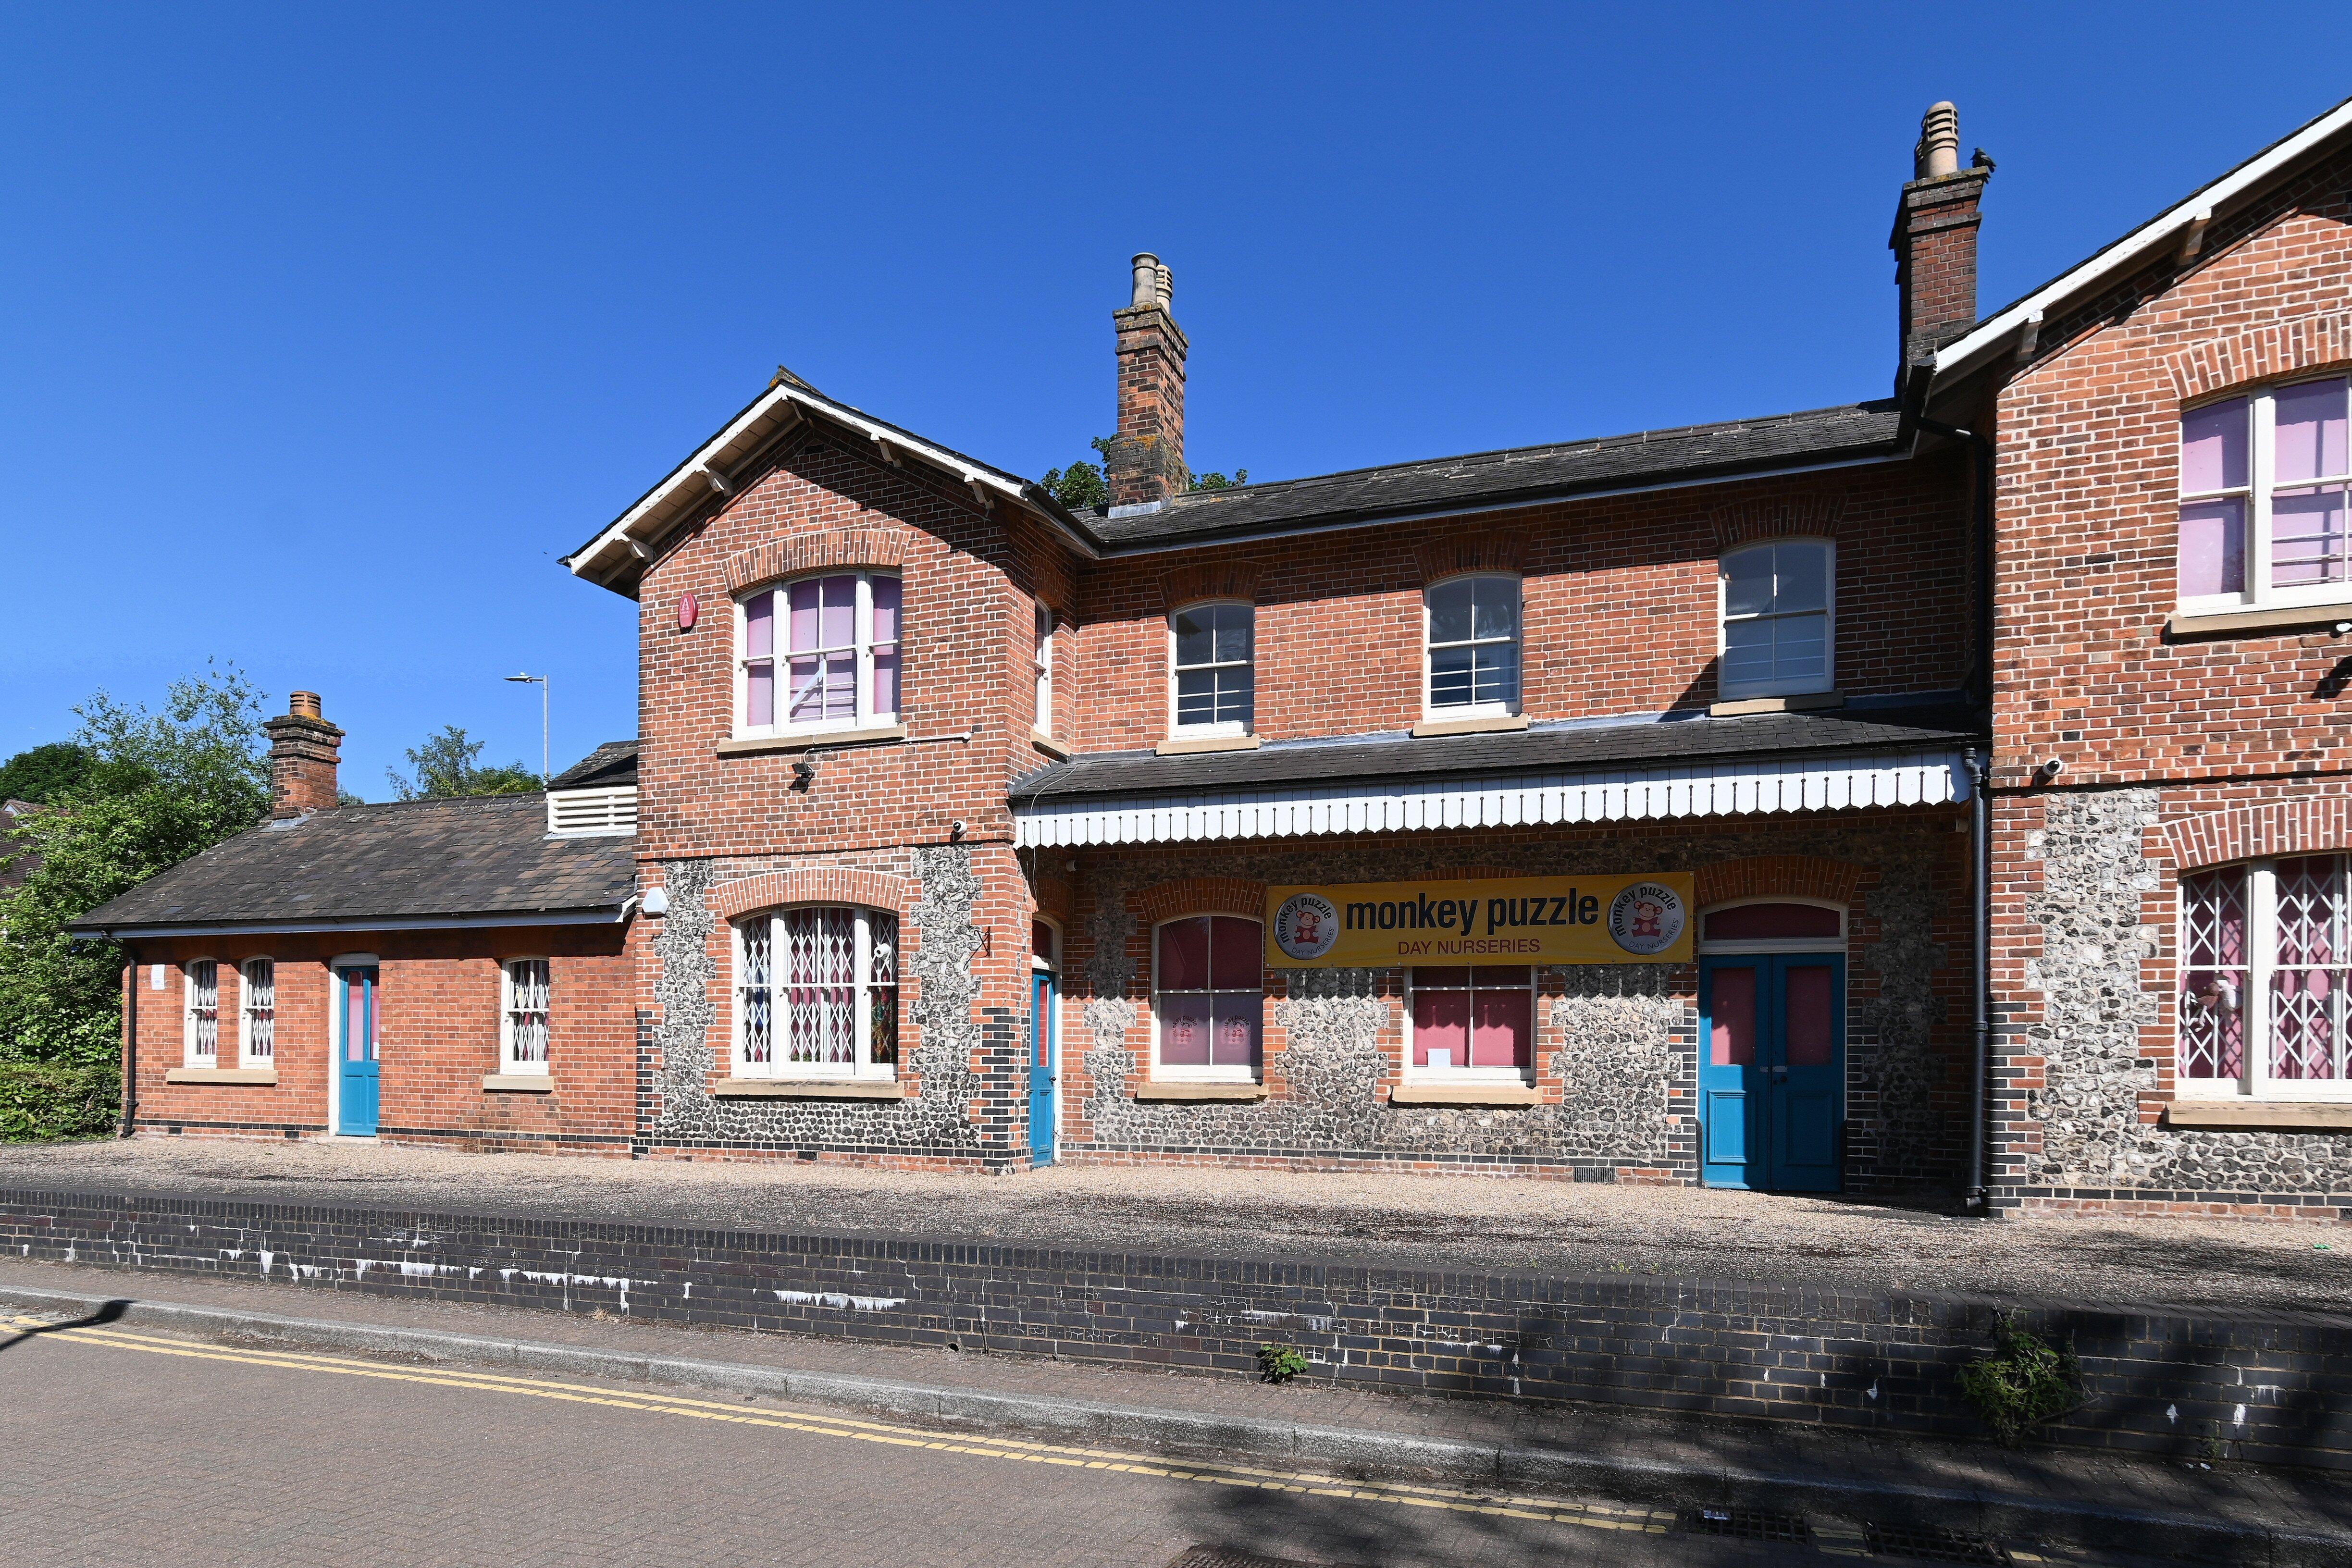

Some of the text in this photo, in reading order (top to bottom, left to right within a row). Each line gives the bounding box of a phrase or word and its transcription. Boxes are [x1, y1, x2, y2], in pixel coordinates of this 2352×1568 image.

[1278, 897, 1332, 943] monkey puzzle
[1347, 888, 1598, 936] monkey puzzle
[1613, 887, 1676, 937] monkey puzzle
[1291, 928, 1334, 955] DAY NURSERIES
[1398, 938, 1540, 955] DAY NURSERIES
[1628, 919, 1679, 950] DAY NURSERIES
[1235, 1015, 1250, 1026] puzzle
